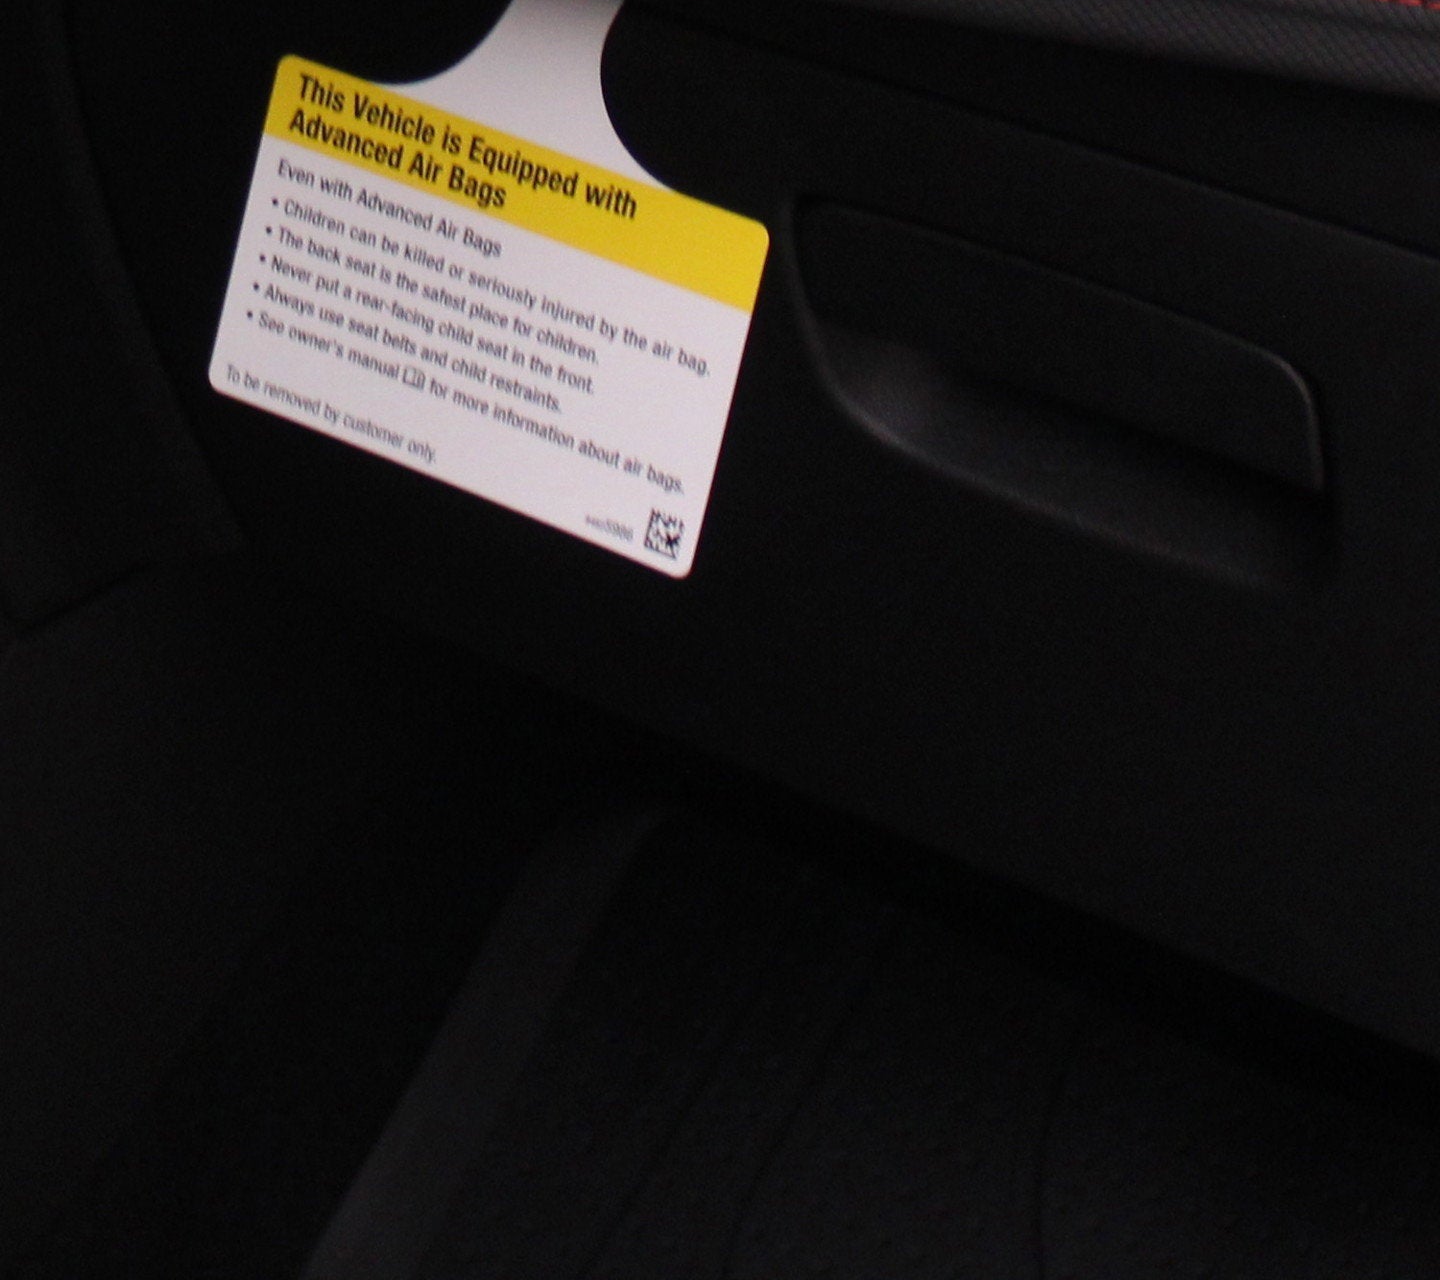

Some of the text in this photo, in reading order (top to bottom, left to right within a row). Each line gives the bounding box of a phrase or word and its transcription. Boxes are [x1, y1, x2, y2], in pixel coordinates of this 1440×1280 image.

[288, 107, 506, 209] Advanced Air Bags
[299, 72, 637, 219] This Vehicle is Equipped with
[277, 157, 501, 257] Even with Advanced Air Bags
[263, 282, 315, 316] Always
[318, 306, 344, 328] use
[347, 317, 379, 342] seat
[381, 327, 417, 356] belts
[419, 345, 448, 368] and
[450, 357, 487, 383] child
[270, 254, 312, 284] Never
[314, 274, 340, 296] put
[355, 289, 434, 335] rear-facing
[437, 320, 474, 347] child
[476, 336, 508, 361] seat
[510, 345, 525, 368] in
[529, 353, 552, 377] the
[278, 224, 303, 250] The
[306, 236, 340, 265] back
[344, 254, 376, 279] seat
[378, 264, 392, 285] is
[395, 270, 418, 294] the
[421, 283, 466, 313] safest
[467, 302, 508, 329] place
[512, 315, 533, 337] for
[283, 197, 345, 235] Children
[349, 225, 376, 247] can
[380, 233, 399, 255] be
[403, 242, 445, 273] killed
[447, 262, 465, 281] or
[467, 270, 537, 311] seriously
[540, 294, 595, 331] injured
[598, 316, 618, 342] by
[622, 326, 647, 351] the
[651, 339, 673, 360] air
[226, 362, 242, 387] To
[245, 373, 260, 391] be
[262, 380, 321, 416] removed
[322, 402, 340, 426] by
[342, 412, 404, 448] customer
[257, 309, 285, 334] See
[288, 325, 343, 359] owner's
[347, 347, 400, 379] manual
[428, 376, 449, 399] for
[451, 388, 489, 415] more
[492, 402, 574, 450] information
[577, 439, 620, 469] about
[622, 457, 643, 476] air
